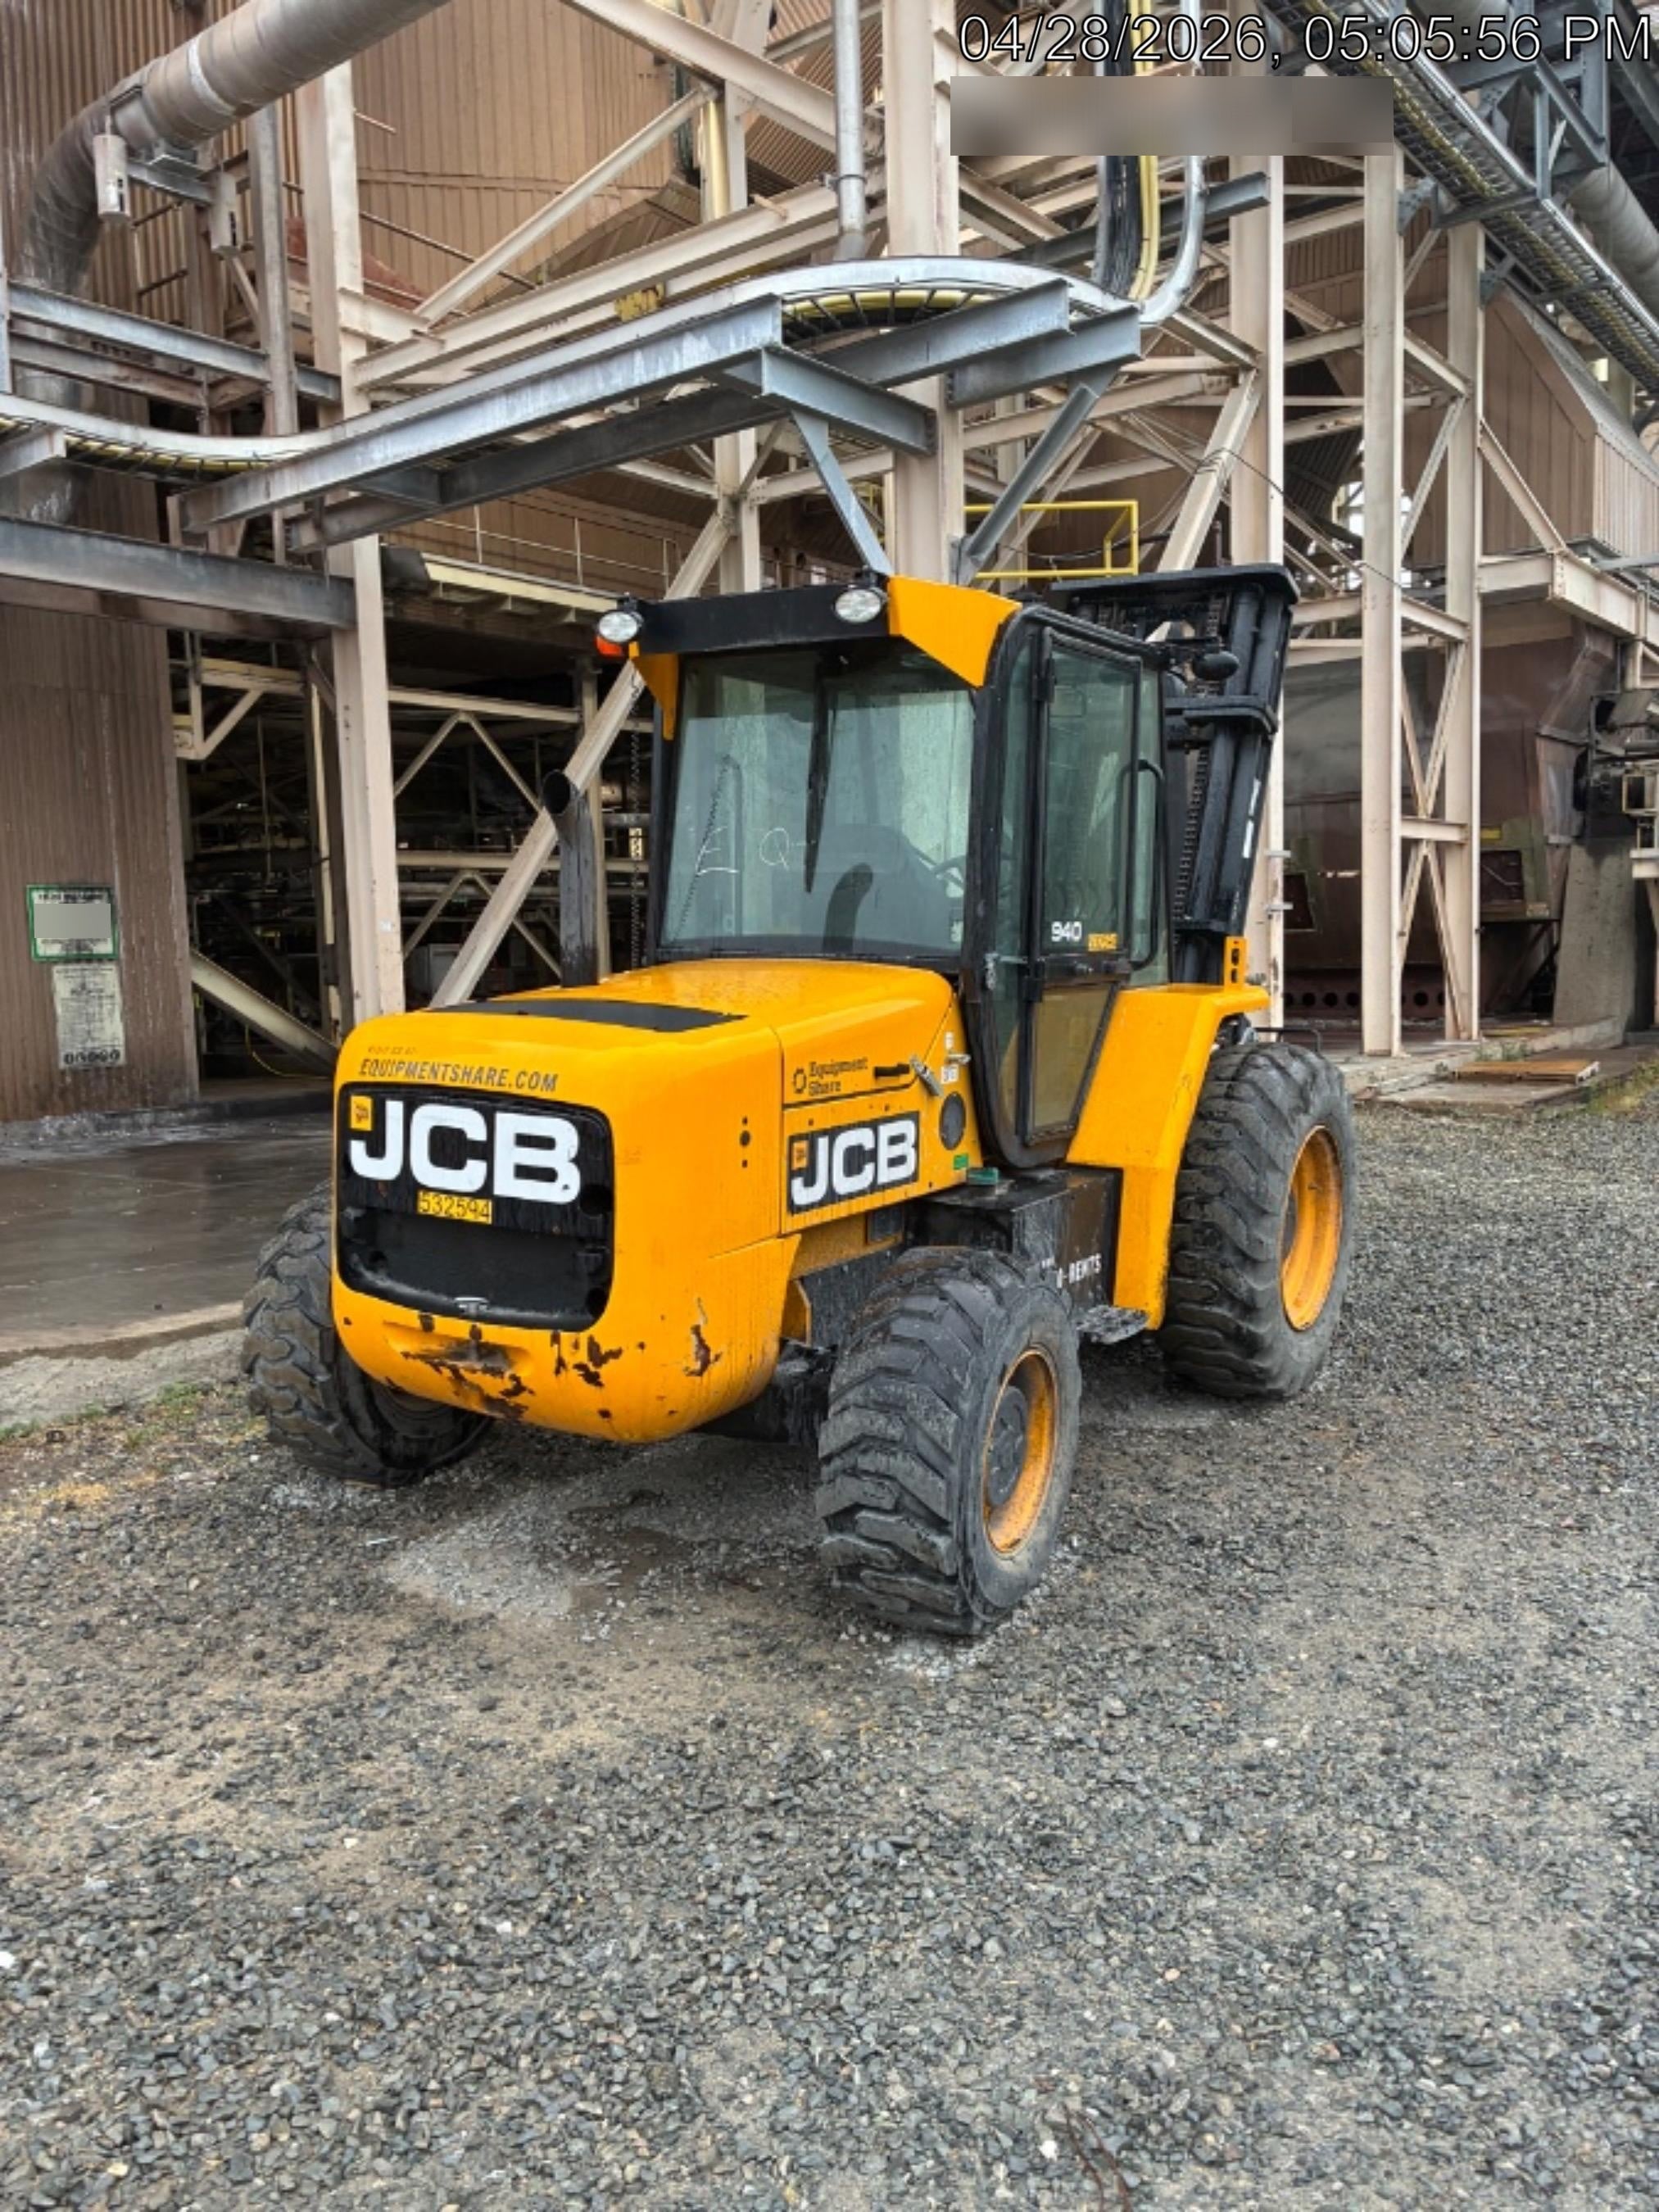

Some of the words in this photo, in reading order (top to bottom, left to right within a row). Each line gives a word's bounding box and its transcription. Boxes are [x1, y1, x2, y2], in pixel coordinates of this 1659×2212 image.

[1051, 921, 1082, 942] 940
[359, 1058, 559, 1092] EQUIPMENTSHARE.COM
[350, 1099, 581, 1205] JCB
[791, 1120, 917, 1205] JCB
[420, 1191, 491, 1222] 532594
